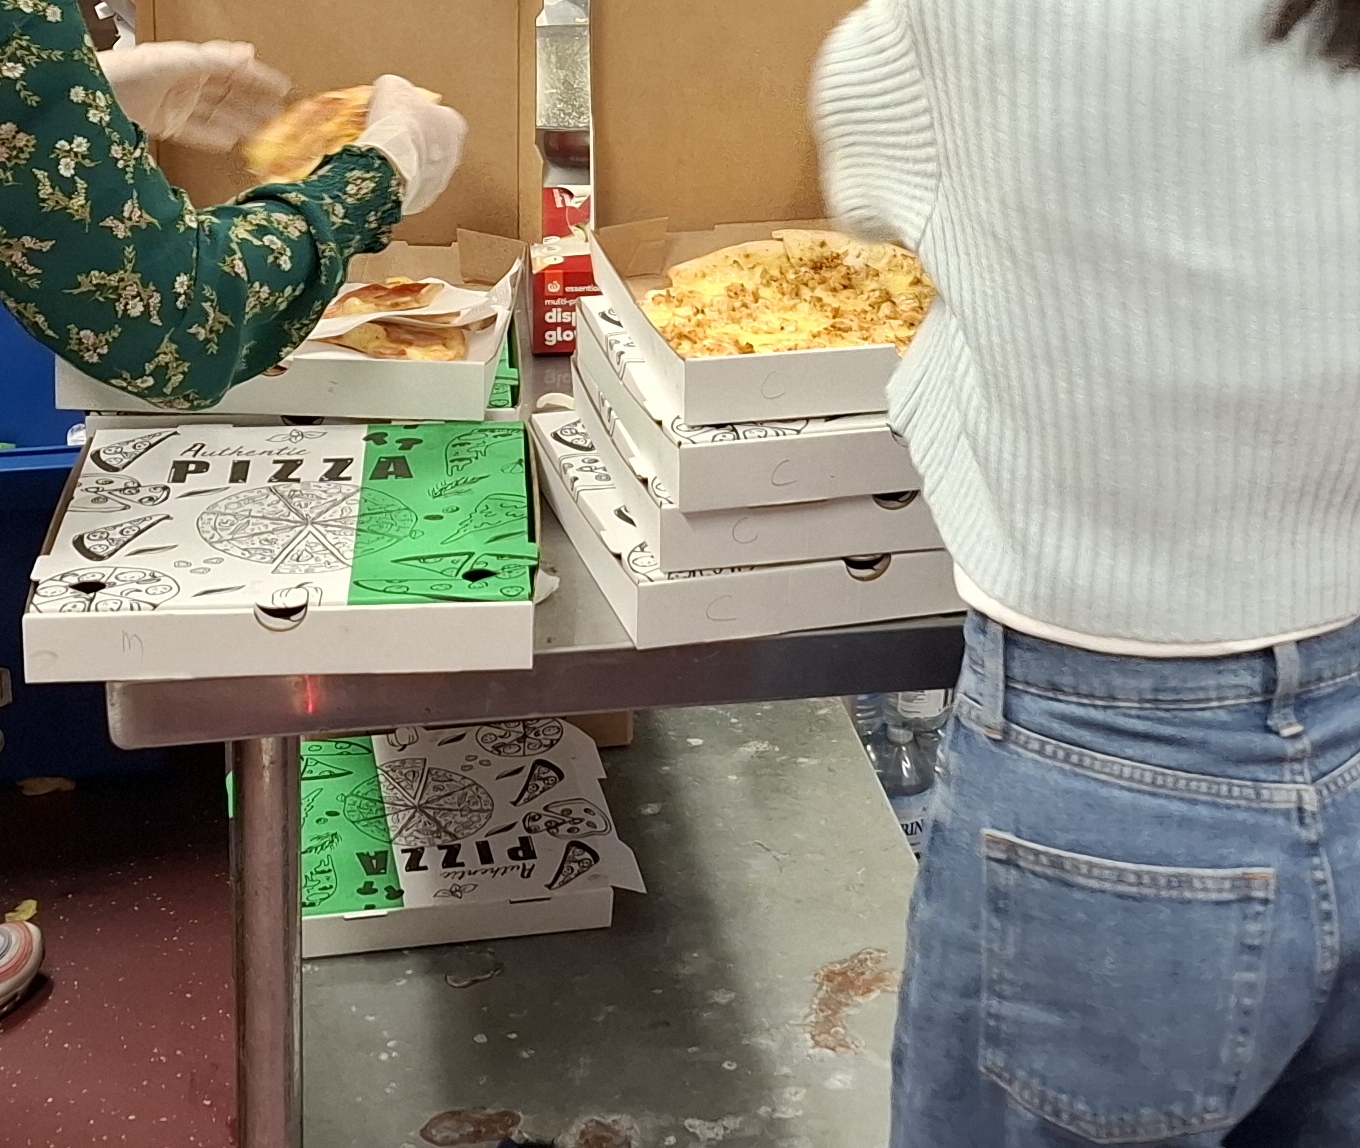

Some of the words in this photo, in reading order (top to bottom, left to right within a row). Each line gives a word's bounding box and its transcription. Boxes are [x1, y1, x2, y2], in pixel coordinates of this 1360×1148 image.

[544, 326, 576, 346] glo
[180, 442, 312, 459] Authentic
[167, 455, 414, 484] PIZZA
[356, 835, 537, 877] PIZZA
[439, 861, 536, 880] Authentic
